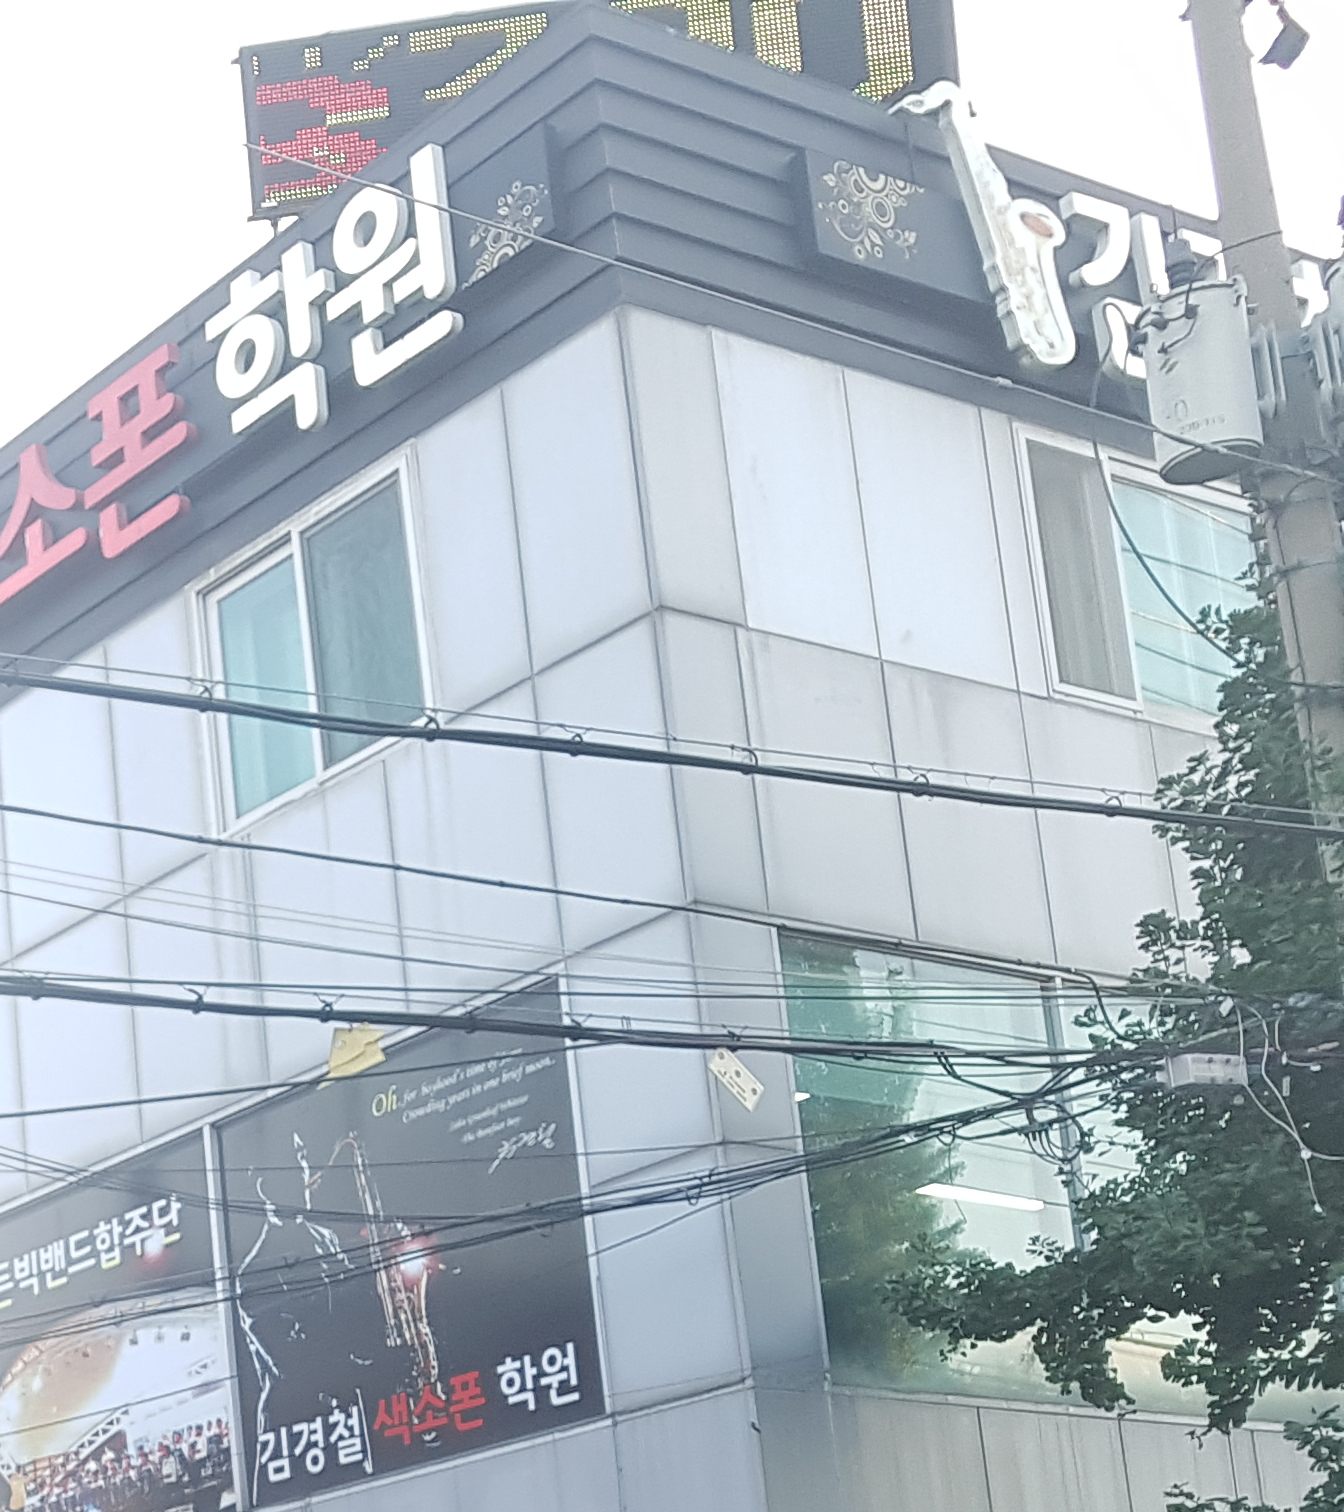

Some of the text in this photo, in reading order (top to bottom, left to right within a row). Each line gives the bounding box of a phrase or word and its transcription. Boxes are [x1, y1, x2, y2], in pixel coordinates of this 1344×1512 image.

[204, 143, 466, 432] 학원
[258, 1341, 580, 1484] 김경철 색소폰 학원
